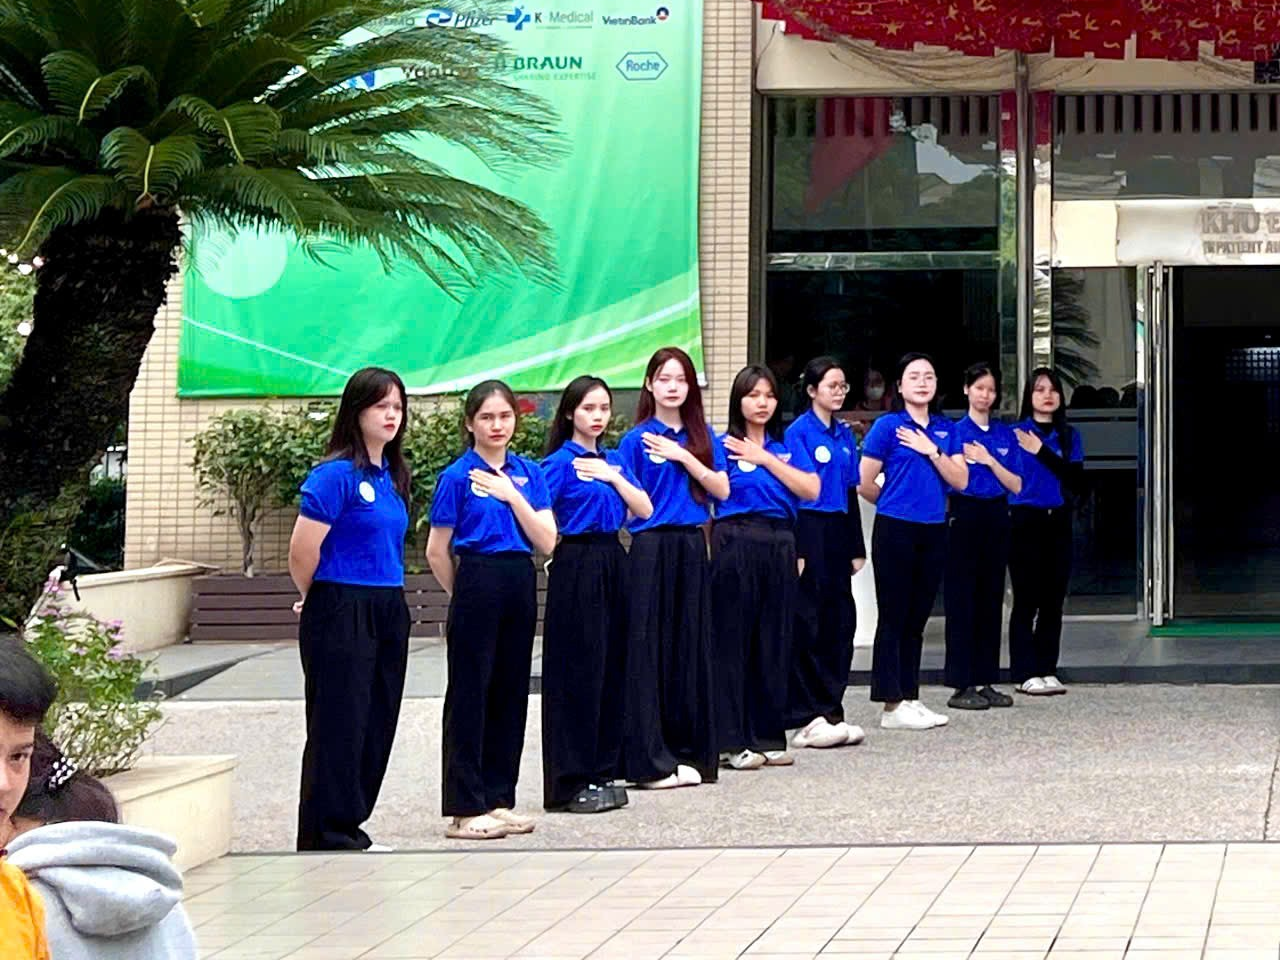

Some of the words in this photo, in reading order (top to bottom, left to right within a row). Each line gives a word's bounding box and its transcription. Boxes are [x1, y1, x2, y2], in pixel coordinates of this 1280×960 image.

[454, 10, 495, 28] Pfizer
[535, 12, 543, 23] K
[550, 10, 594, 23] Medical
[512, 56, 582, 70] BRAUN
[626, 60, 660, 72] Roche
[1202, 210, 1260, 234] KHU
